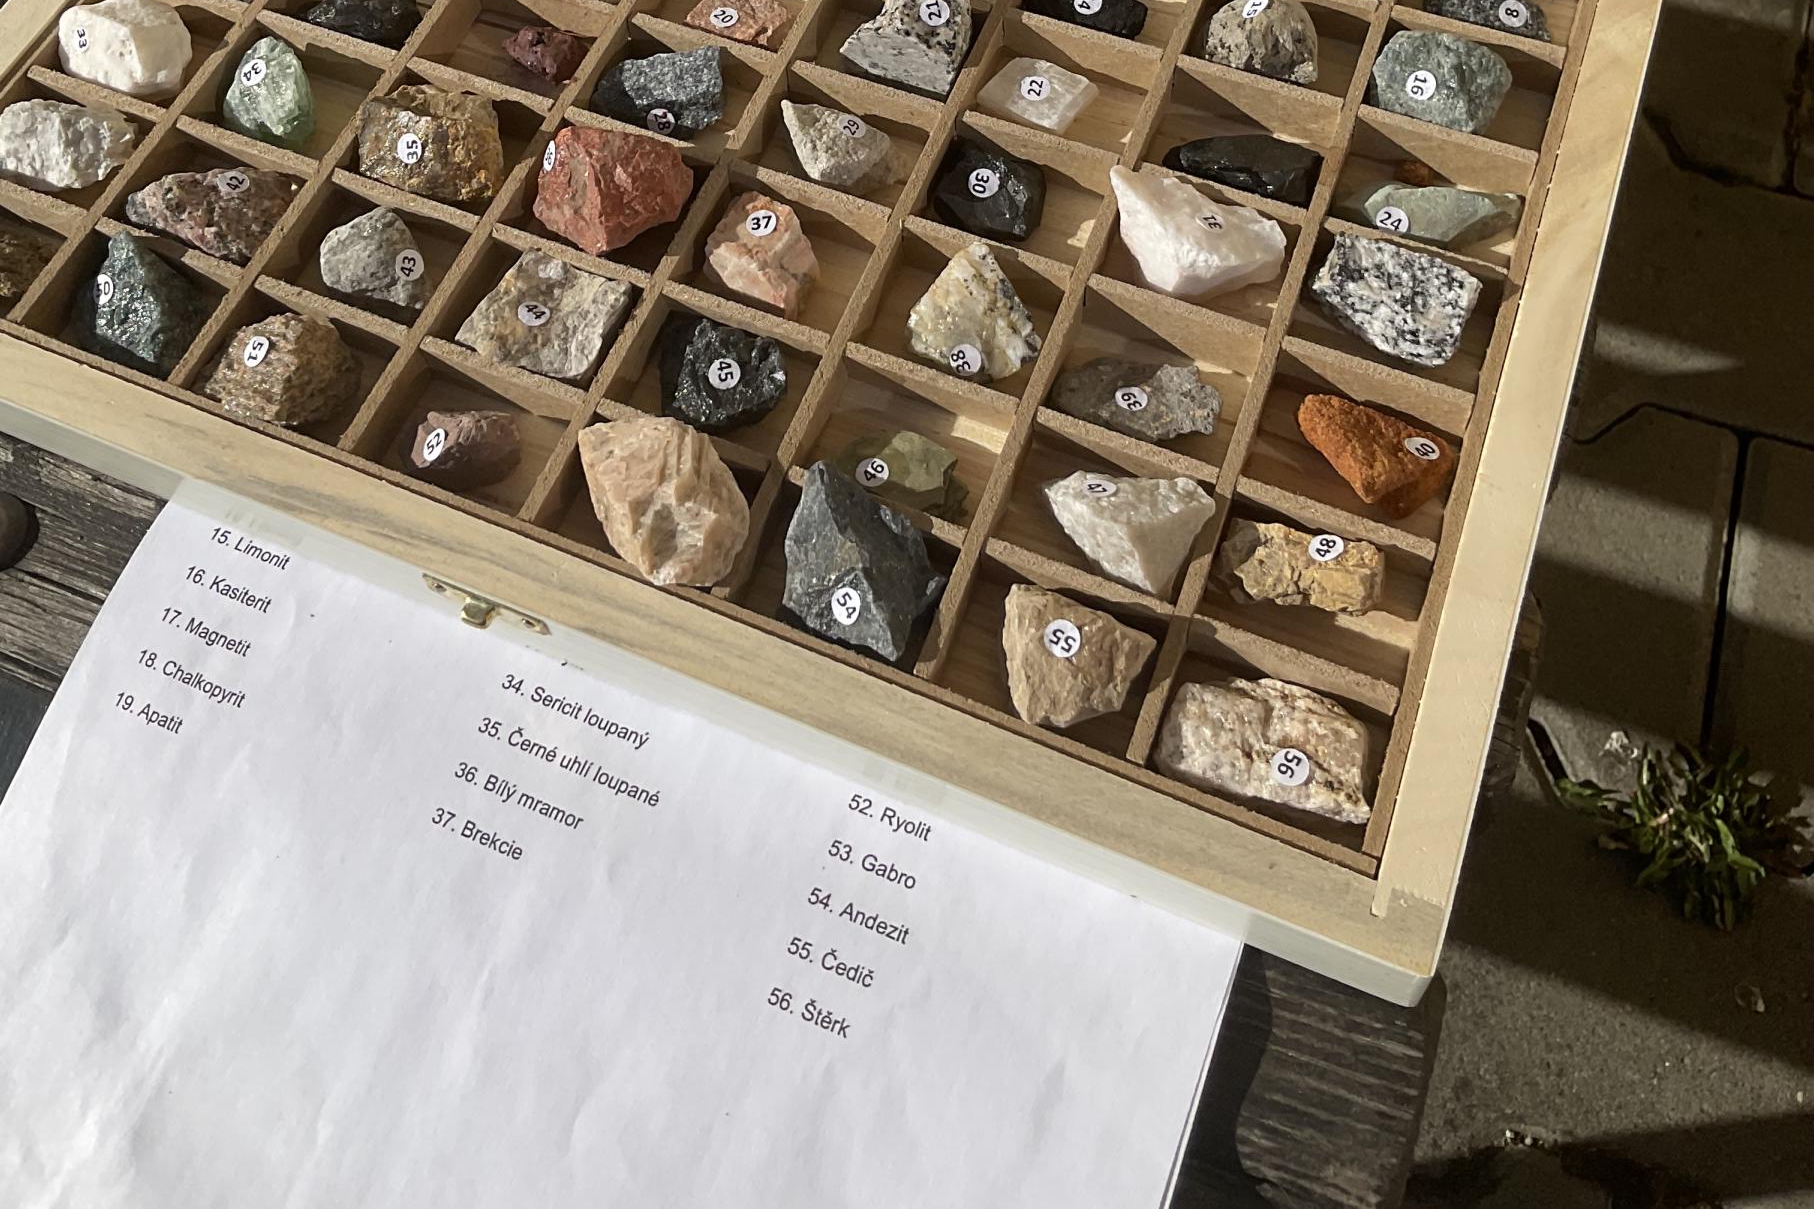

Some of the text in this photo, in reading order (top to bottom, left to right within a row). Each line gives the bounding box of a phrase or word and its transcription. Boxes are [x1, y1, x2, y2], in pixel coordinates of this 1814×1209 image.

[712, 8, 734, 24] 20
[925, 0, 943, 21] 21
[1503, 5, 1519, 19] 8
[75, 28, 88, 50] 33
[242, 61, 262, 83] 34
[1027, 78, 1045, 98] 22
[1409, 74, 1428, 97] 16
[652, 112, 671, 132] 28
[841, 118, 861, 137] 29
[405, 138, 420, 162] 35
[225, 174, 246, 192] 42
[971, 173, 991, 194] 30
[749, 214, 774, 232] 37
[1201, 213, 1223, 231] 31
[1378, 210, 1403, 232] 24
[400, 255, 417, 278] 43
[95, 280, 112, 298] 50
[524, 303, 547, 321] 44
[246, 340, 265, 363] 51
[950, 349, 972, 375] 38
[715, 359, 734, 383] 45
[1121, 392, 1143, 411] 39
[425, 432, 443, 454] 52
[1414, 442, 1436, 459] 40
[863, 459, 885, 483] 46
[1086, 482, 1109, 495] 47
[211, 527, 291, 571] 15. Limonit
[1314, 537, 1338, 559] 48
[185, 565, 273, 614] 16. Kasiterit
[835, 591, 858, 621] 54
[161, 606, 252, 658] 17. Magnetit
[1047, 626, 1078, 654] 55
[138, 649, 246, 709] 18. Chalkopyrit
[115, 691, 184, 735] 19. Apatit
[501, 673, 650, 751] 34. Sericit loupaný
[477, 717, 661, 807] 35. Černé uhlí loupané
[1275, 750, 1303, 780] 56
[454, 761, 585, 830] 36. Bílý mramor
[848, 793, 932, 842] 52. Ryolit
[431, 807, 523, 861] 37. Brekcie
[827, 839, 917, 890] 53. Gabro
[807, 886, 910, 945] 54. Andezit
[787, 936, 875, 988] 55. Čedič
[767, 986, 851, 1039] 56. Štěrk
